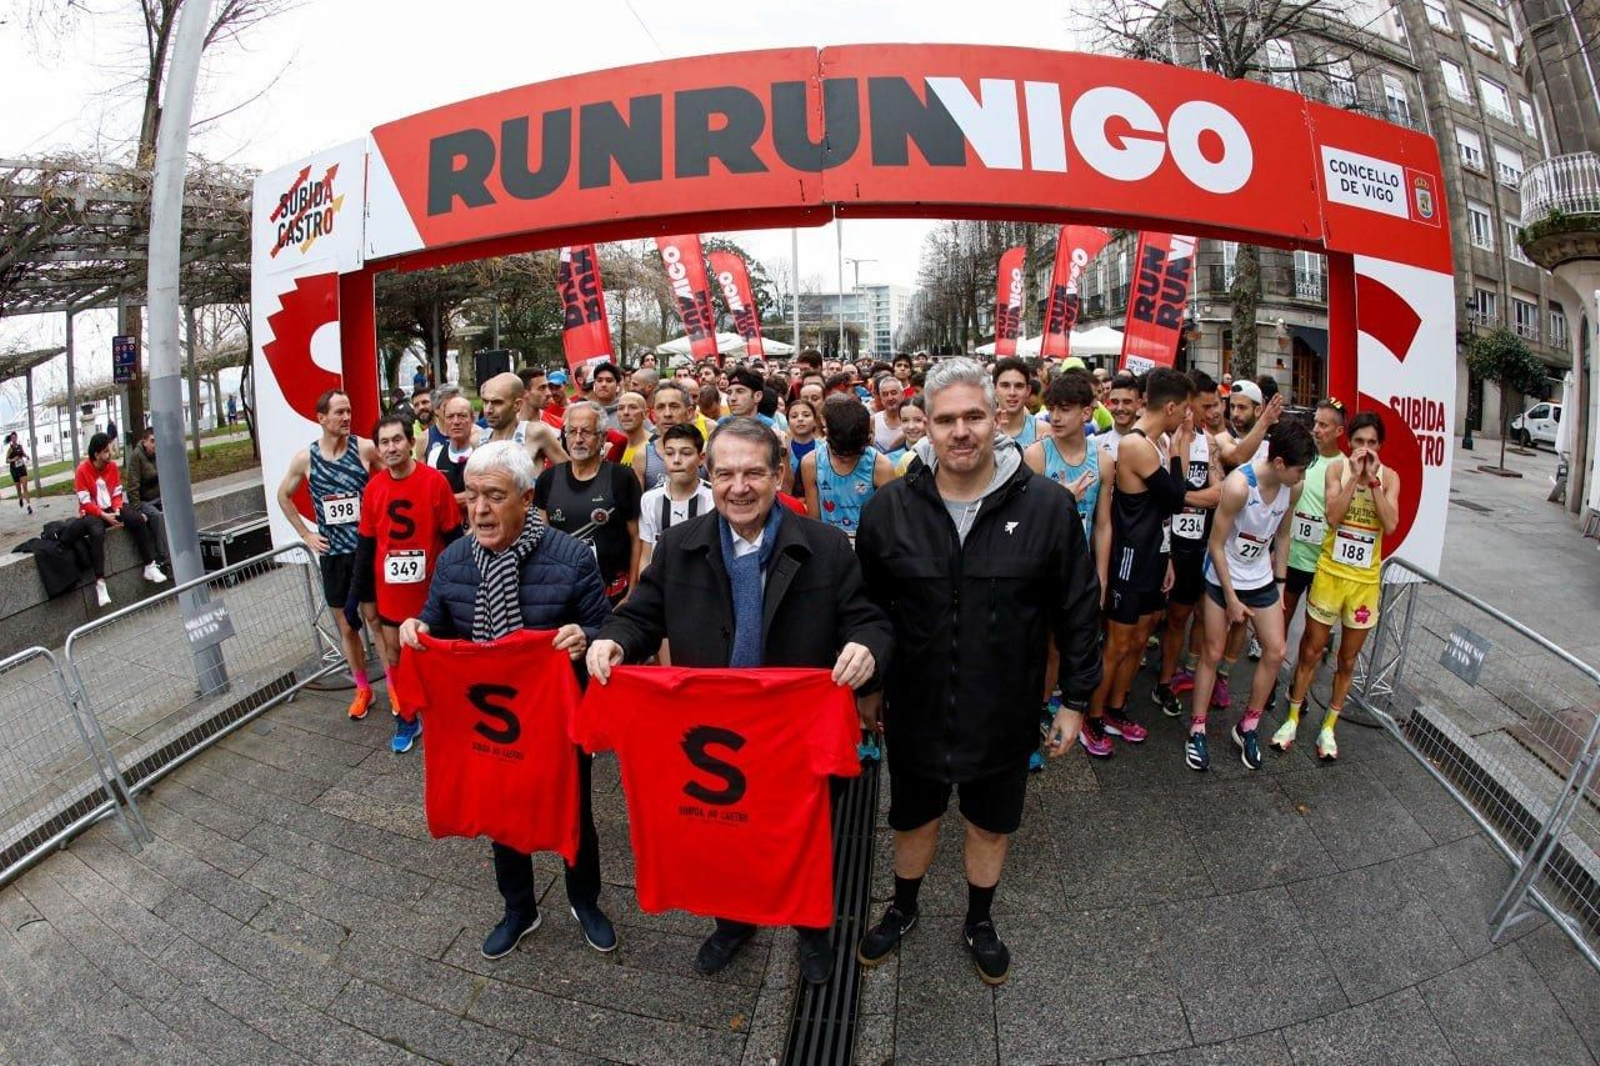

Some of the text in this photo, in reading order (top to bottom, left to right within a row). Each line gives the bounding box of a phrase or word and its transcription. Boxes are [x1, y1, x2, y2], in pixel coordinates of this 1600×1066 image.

[1329, 159, 1399, 188] CONCELLO
[1340, 178, 1394, 203] DE VIGO
[279, 177, 333, 219] SUBIDA
[277, 207, 333, 249] CASTRO
[1133, 244, 1167, 324] RUN
[1049, 284, 1067, 335] RUN
[1389, 395, 1446, 433] SUBIDA
[1417, 434, 1445, 467] TRO
[329, 503, 354, 518] 398
[387, 499, 415, 540] S
[1299, 523, 1311, 537] 18
[391, 561, 418, 576] 349
[1240, 544, 1262, 558] 27
[1342, 543, 1365, 561] 188
[466, 683, 521, 744] S
[681, 725, 746, 806] S
